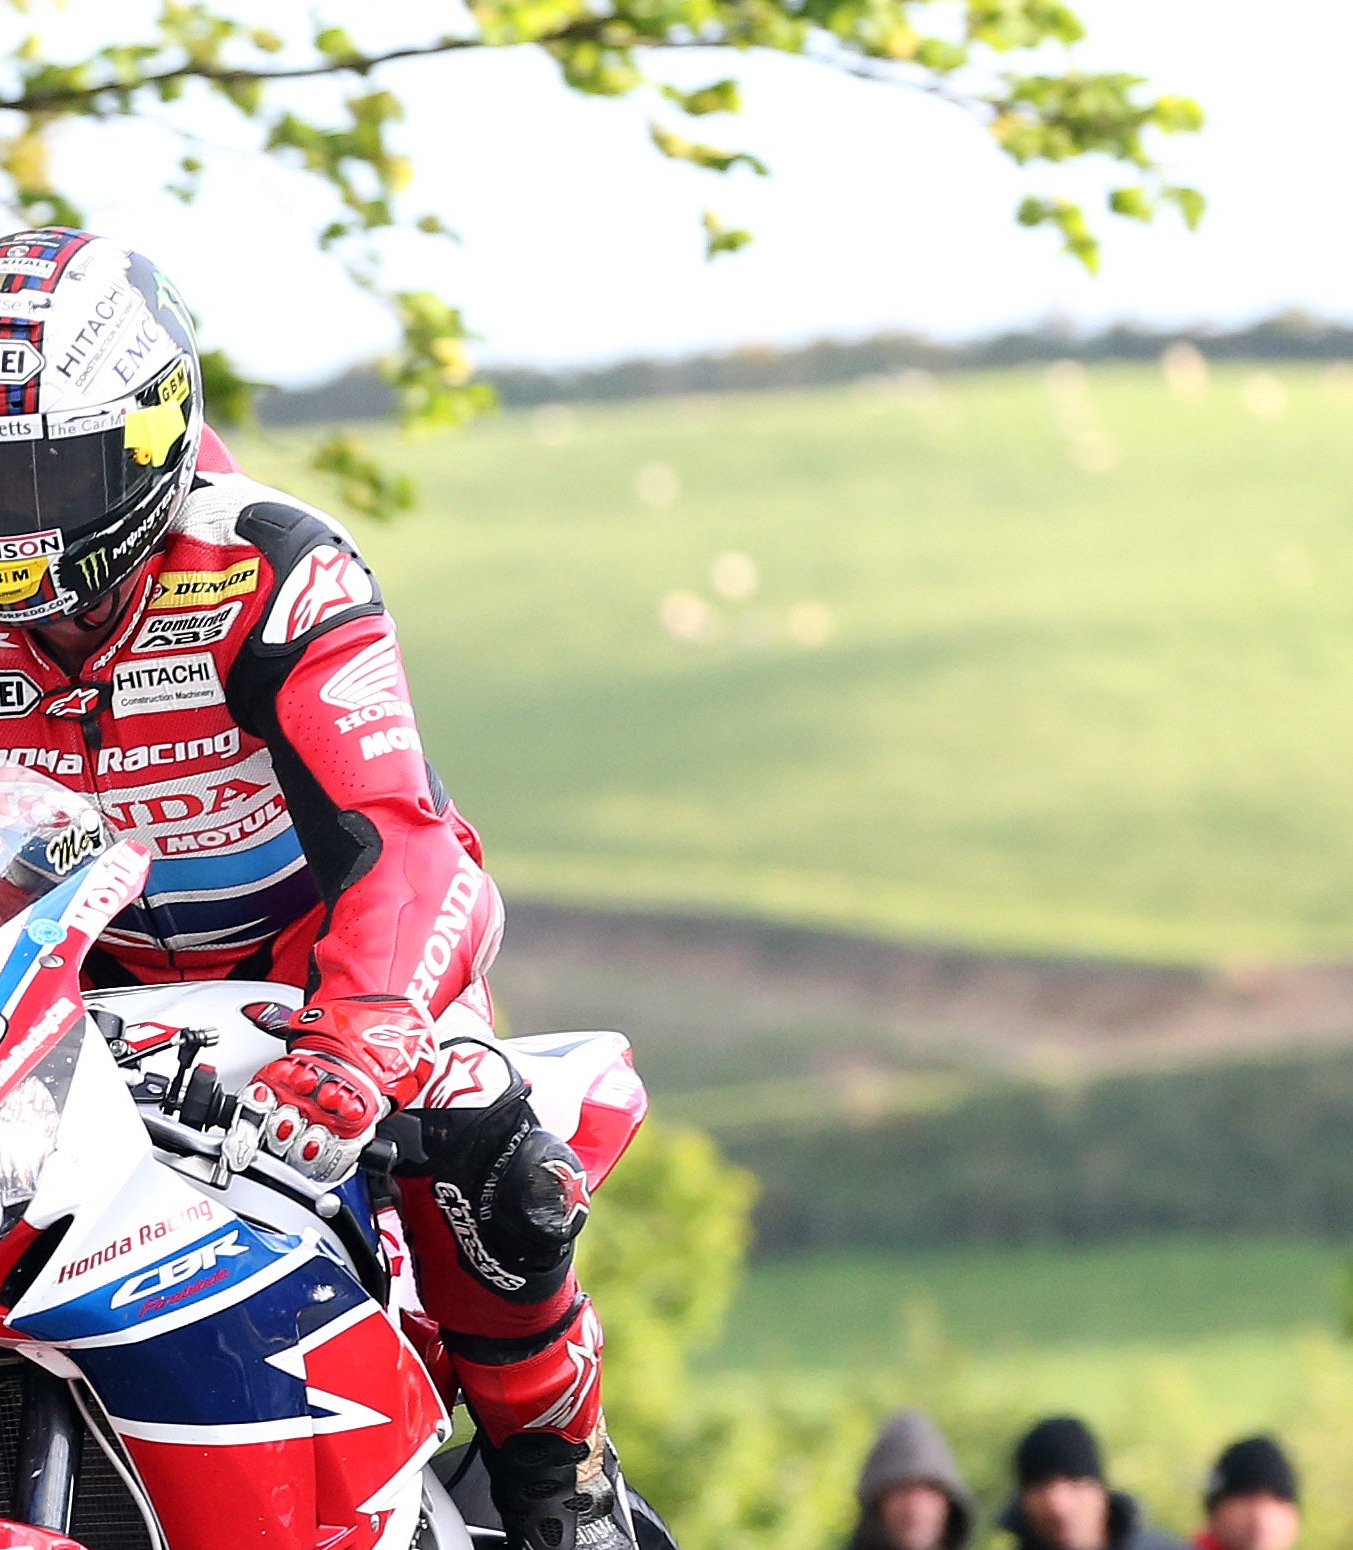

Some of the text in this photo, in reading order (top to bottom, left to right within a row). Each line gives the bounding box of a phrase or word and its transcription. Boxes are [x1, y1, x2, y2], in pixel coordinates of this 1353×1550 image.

[49, 423, 77, 436] The
[174, 569, 255, 595] DUNLOP
[138, 624, 223, 649] ABS
[148, 606, 233, 634] Combined
[116, 662, 210, 692] HITACHI
[97, 726, 240, 776] Racing
[165, 801, 283, 855] MOTUL
[479, 1172, 499, 1221] AHEAD
[57, 1199, 214, 1285] Honda Racing
[110, 1229, 250, 1310] CBR
